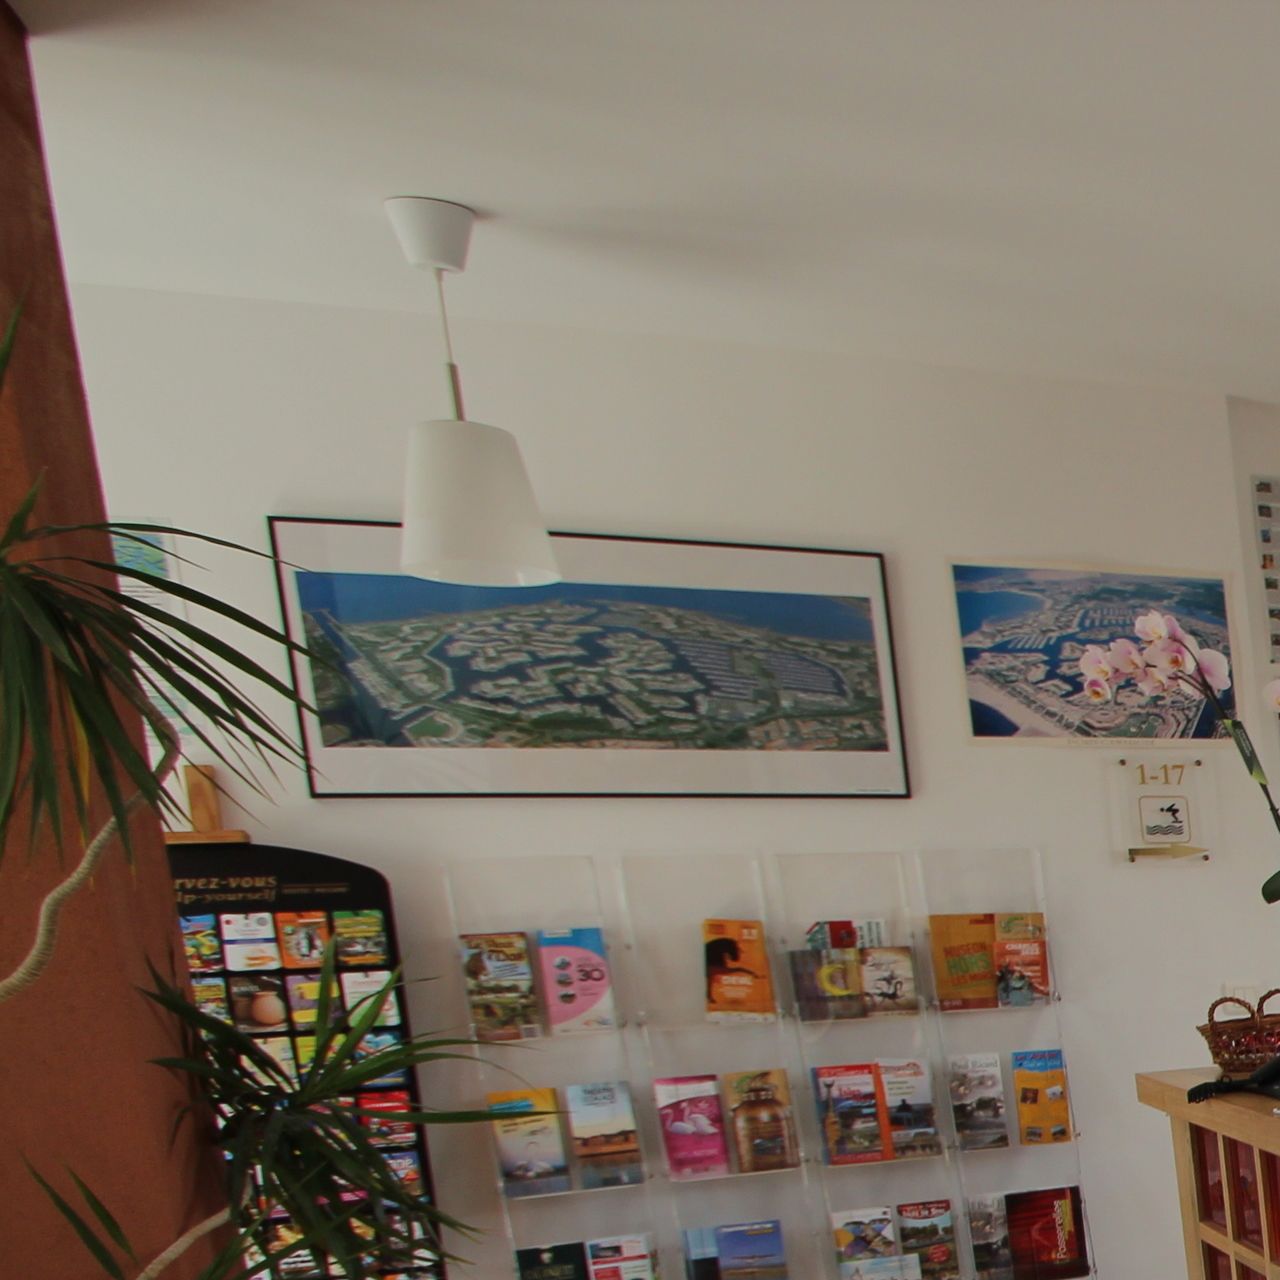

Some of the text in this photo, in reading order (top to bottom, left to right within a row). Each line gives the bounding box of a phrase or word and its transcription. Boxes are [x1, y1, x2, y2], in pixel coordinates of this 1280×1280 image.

[1136, 763, 1186, 786] 1-17
[174, 876, 277, 889] rvez-vous
[176, 890, 276, 904] lp-yourself
[577, 968, 605, 982] 30
